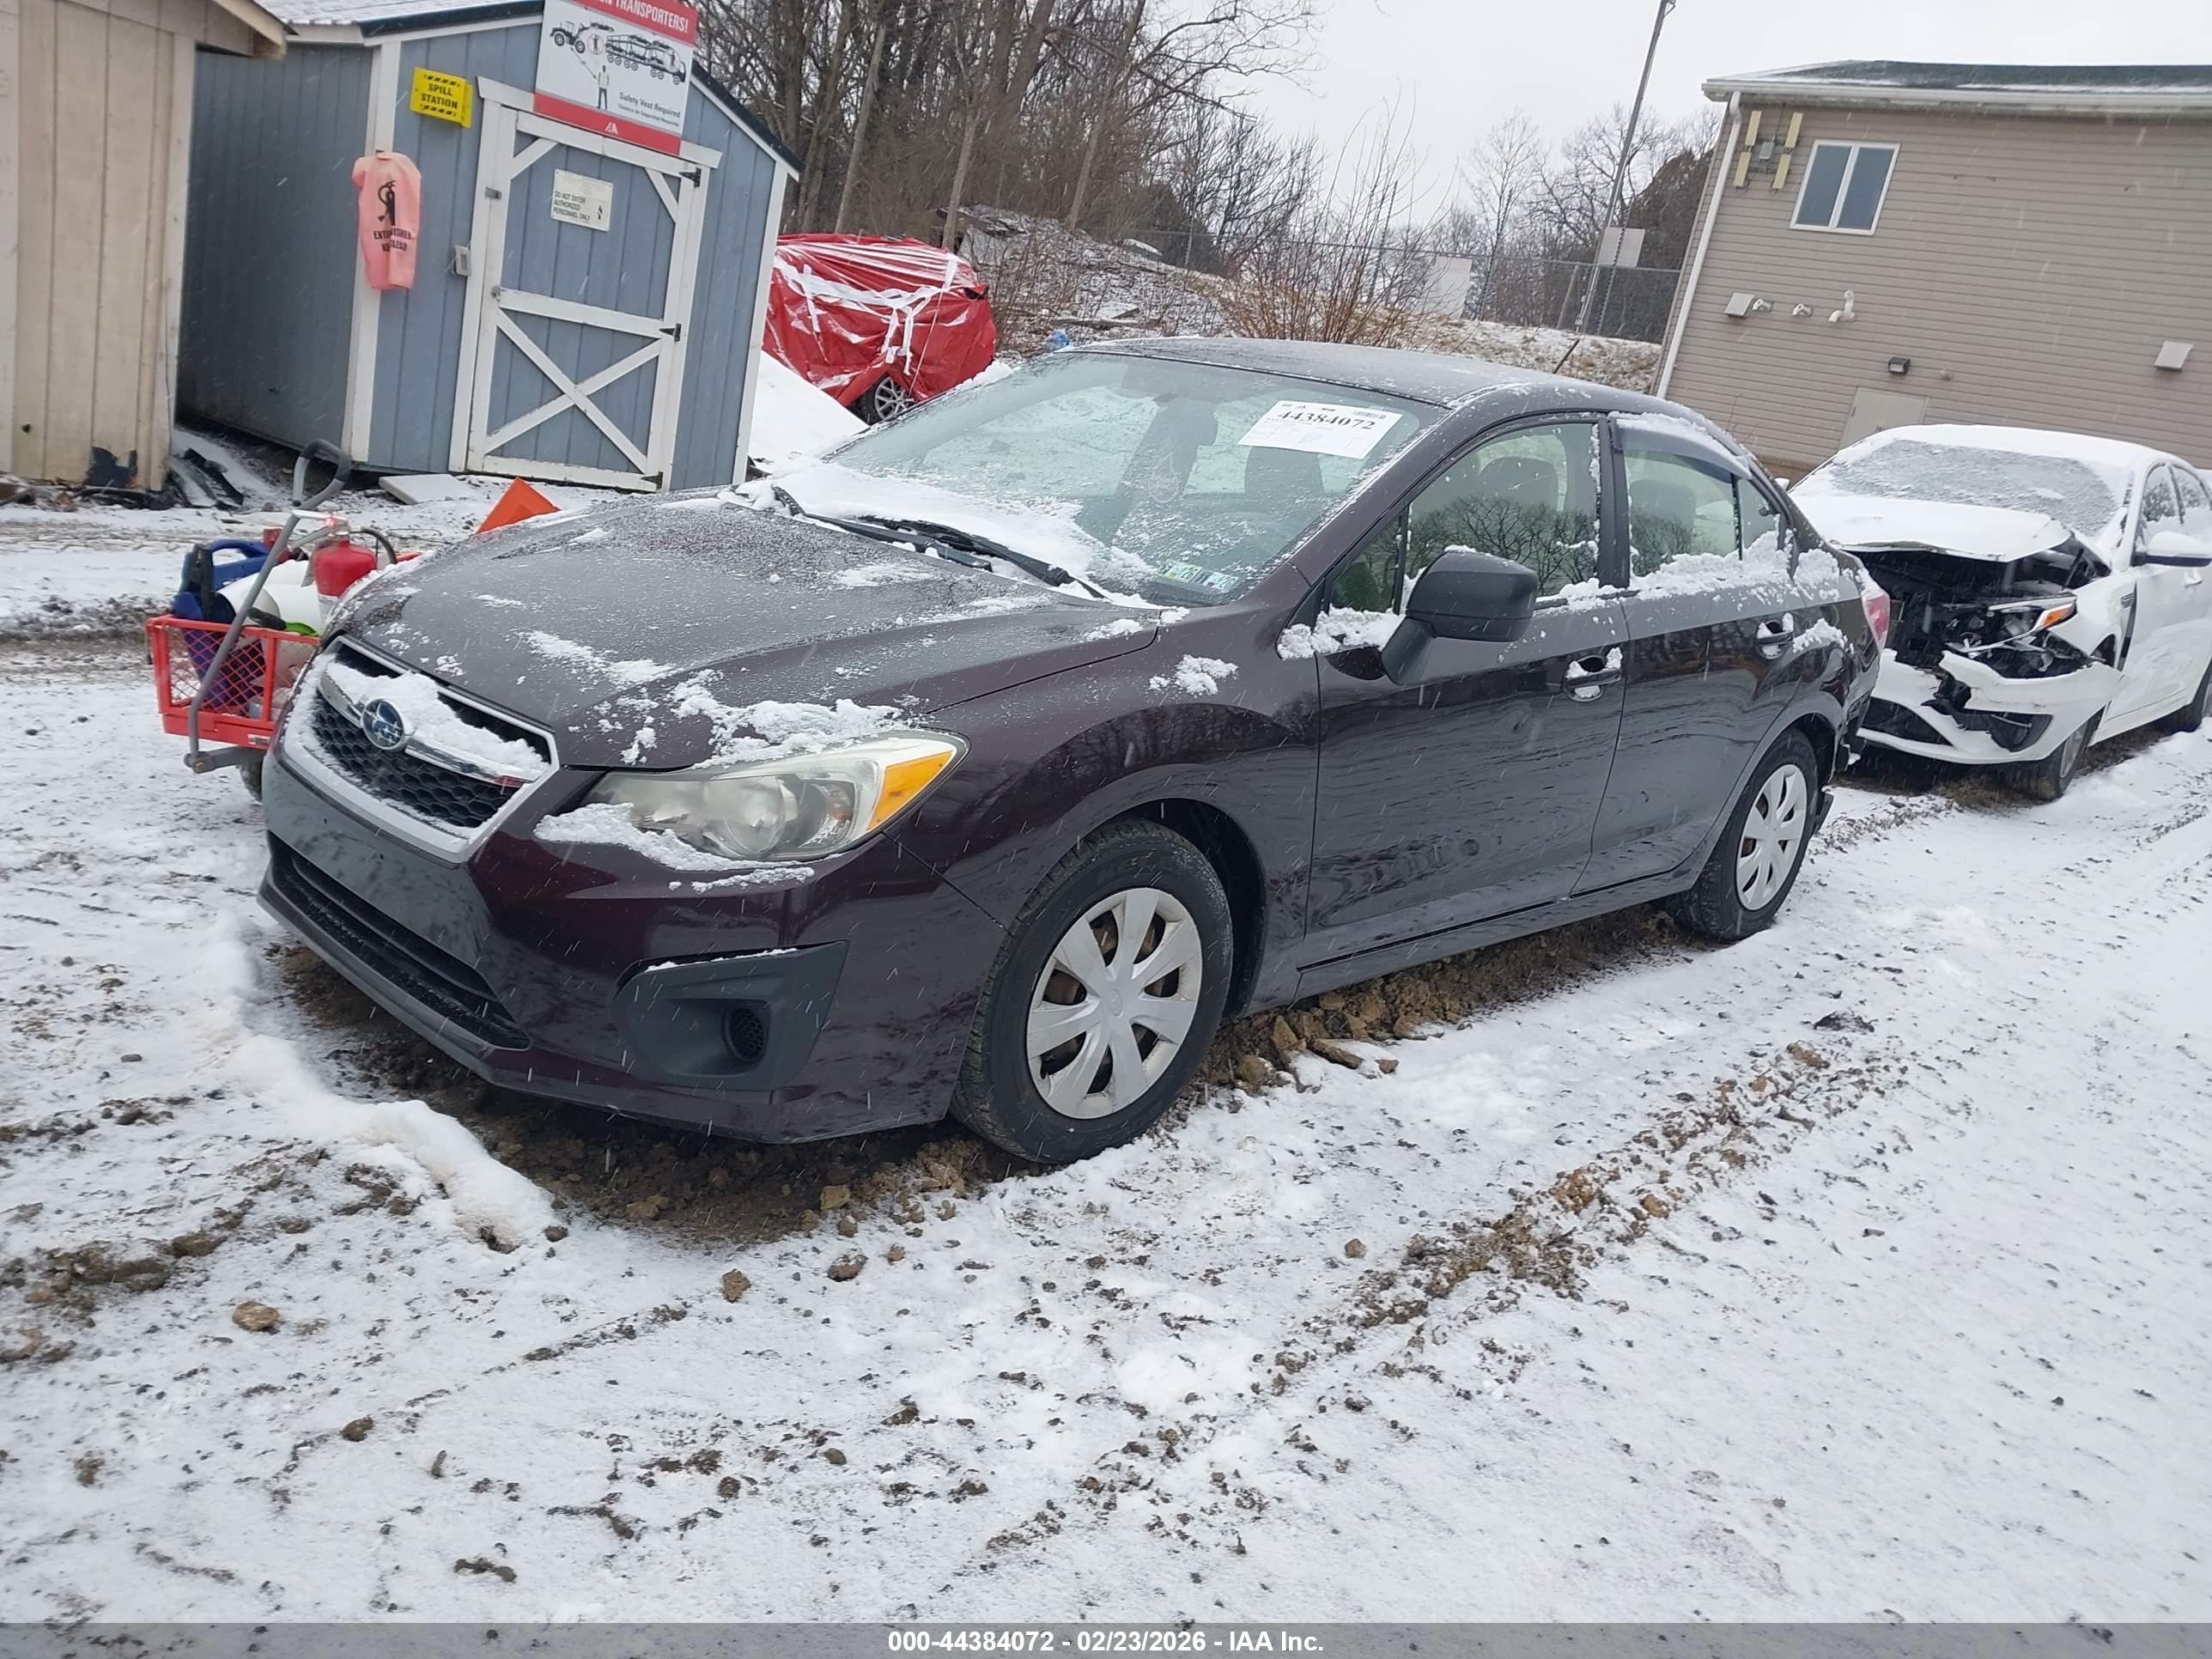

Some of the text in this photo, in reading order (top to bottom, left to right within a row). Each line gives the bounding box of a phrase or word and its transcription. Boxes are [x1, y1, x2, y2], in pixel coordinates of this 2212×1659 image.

[428, 83, 453, 96] SPILL
[421, 93, 459, 109] STATION
[619, 92, 681, 118] Safety Vest Required
[554, 199, 580, 210] AUTHORIZED
[1277, 410, 1376, 430] 44384072
